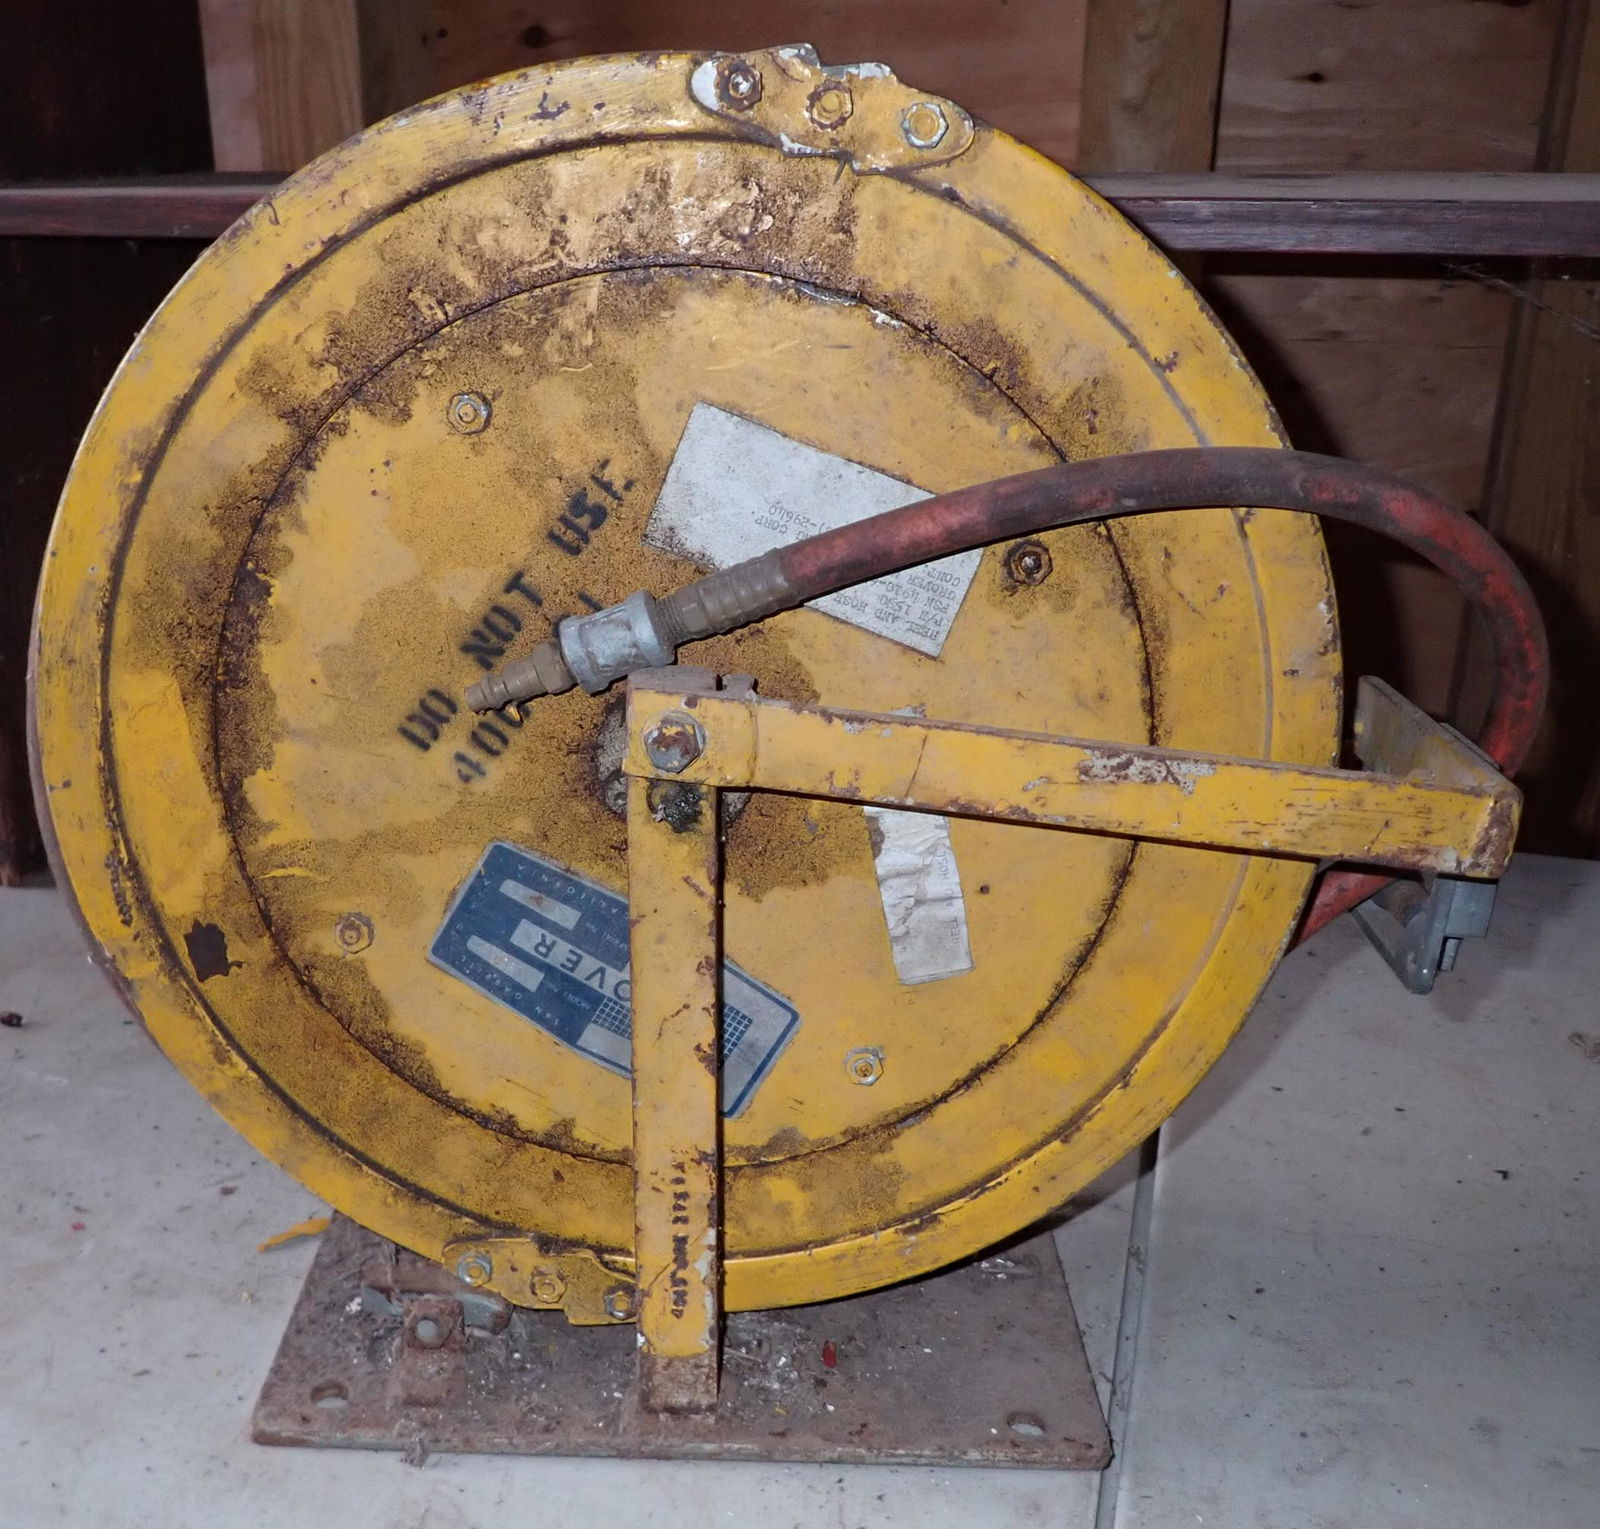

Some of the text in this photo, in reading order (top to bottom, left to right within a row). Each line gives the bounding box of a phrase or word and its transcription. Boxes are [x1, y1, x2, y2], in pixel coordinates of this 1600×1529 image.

[397, 688, 458, 751] DO
[459, 570, 543, 671] NOT
[549, 458, 636, 556] USE
[832, 592, 938, 641] REEL AND HOSE
[907, 574, 955, 600] GROVER
[532, 933, 631, 1002] OVER
